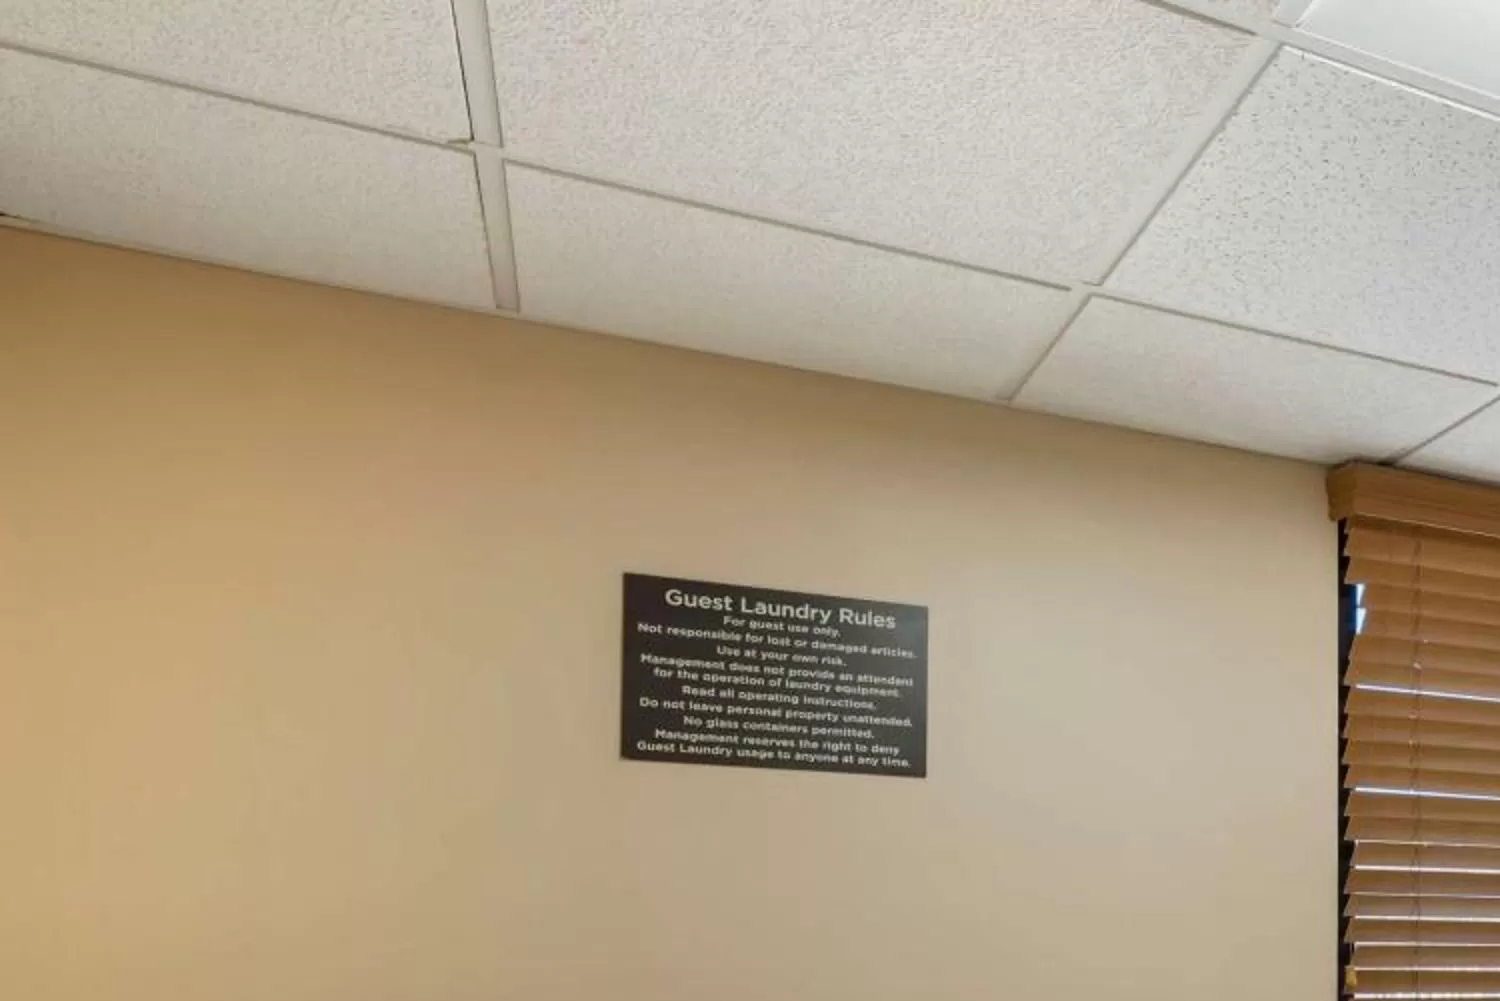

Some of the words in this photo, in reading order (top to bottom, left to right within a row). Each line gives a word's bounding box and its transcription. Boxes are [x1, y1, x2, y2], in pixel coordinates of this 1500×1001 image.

[664, 588, 733, 612] Guest
[740, 596, 831, 625] Laundry
[839, 607, 896, 629] Rules
[637, 621, 662, 634] Not
[667, 625, 742, 641] responsible
[745, 632, 763, 643] for
[767, 634, 791, 646] lost
[794, 638, 807, 648] or
[811, 640, 867, 655] damaged
[870, 646, 917, 659] articles.
[723, 615, 745, 627] For
[749, 618, 784, 632] guest
[787, 622, 809, 633] use
[813, 625, 841, 639] only.
[640, 653, 725, 671] Management
[729, 663, 760, 673] does
[763, 666, 785, 676] not
[788, 667, 835, 680] provide
[838, 673, 853, 682] an
[716, 645, 740, 656] Use
[744, 648, 757, 658] at
[760, 650, 789, 661] your
[791, 653, 818, 664] own
[821, 655, 847, 667] risk.
[653, 667, 673, 678] for
[677, 670, 699, 680] the
[702, 673, 765, 685] operation
[768, 677, 782, 687] of
[785, 678, 832, 693] laundry
[682, 685, 716, 697] Read
[719, 688, 735, 699] all
[737, 690, 800, 705] operating
[639, 696, 659, 708] Do
[663, 700, 686, 710] not
[689, 701, 723, 713] leave
[727, 705, 782, 717] personal
[785, 709, 839, 723] property
[683, 715, 703, 727] No
[706, 717, 739, 730] glass
[742, 721, 808, 734] containers
[811, 726, 875, 740] permitted.
[637, 740, 676, 753] Guest
[679, 743, 734, 758] Laundry
[736, 748, 775, 760] usage
[777, 751, 791, 760] to
[794, 752, 839, 764] anyone
[841, 755, 854, 765] at
[857, 757, 878, 767] any
[655, 729, 739, 744] Management
[743, 736, 795, 748] reserves
[799, 739, 820, 750] the
[823, 741, 852, 754] right
[855, 743, 869, 754] to
[871, 745, 900, 758] deny
